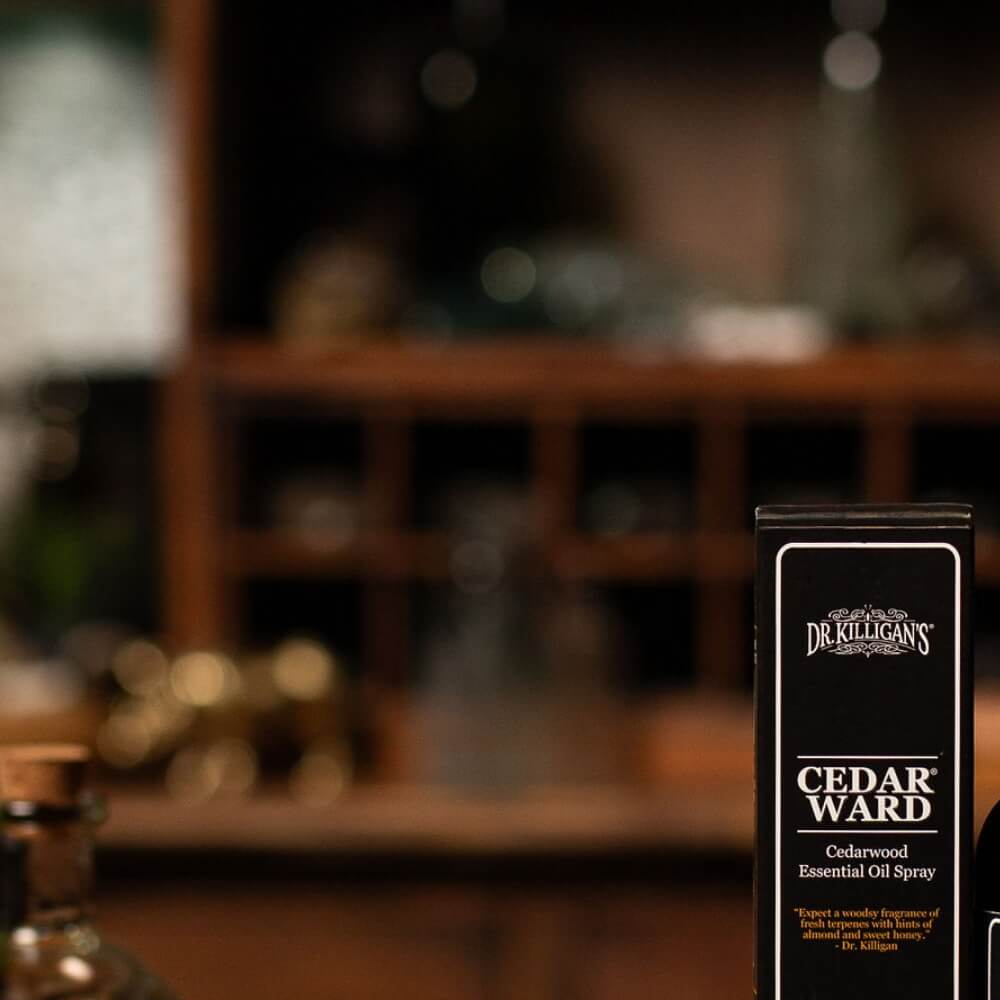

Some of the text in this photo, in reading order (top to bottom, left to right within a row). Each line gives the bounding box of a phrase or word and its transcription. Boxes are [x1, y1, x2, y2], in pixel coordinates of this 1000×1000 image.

[805, 795, 932, 822] WARD
[826, 844, 908, 859] Cedarwood
[799, 864, 936, 881] Essential Oil Spray
[842, 907, 879, 919] woodsy
[881, 907, 927, 919] fragrance
[929, 907, 940, 918] of
[800, 918, 933, 930] fresh terpenes with hints of
[803, 929, 840, 939] almond
[842, 929, 861, 939] and
[863, 930, 890, 939] sweet
[842, 941, 858, 950] Dr.
[860, 941, 898, 952] Killigan
